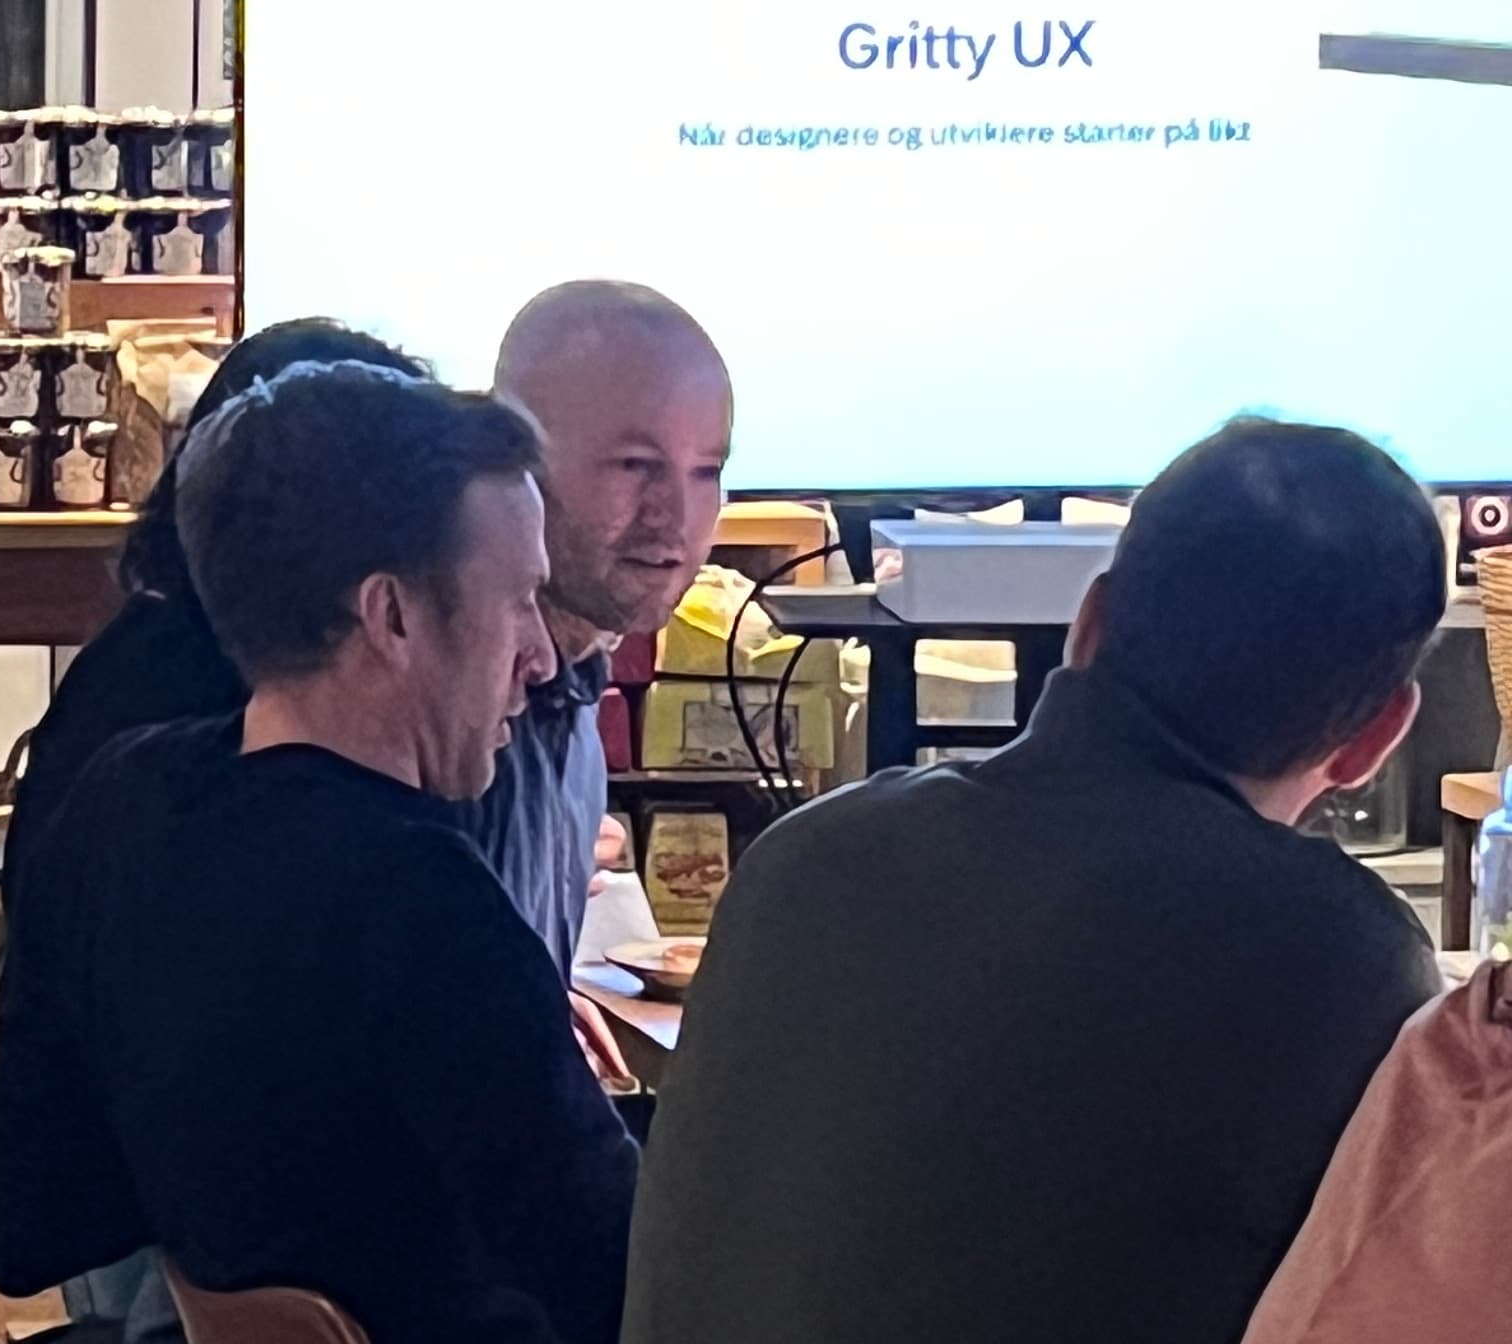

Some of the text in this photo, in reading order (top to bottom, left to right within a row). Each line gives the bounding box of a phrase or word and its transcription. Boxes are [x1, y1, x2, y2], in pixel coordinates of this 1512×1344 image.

[838, 20, 1096, 81] Gritty UX
[737, 124, 879, 150] designere
[887, 126, 923, 151] og
[1163, 117, 1200, 149] på
